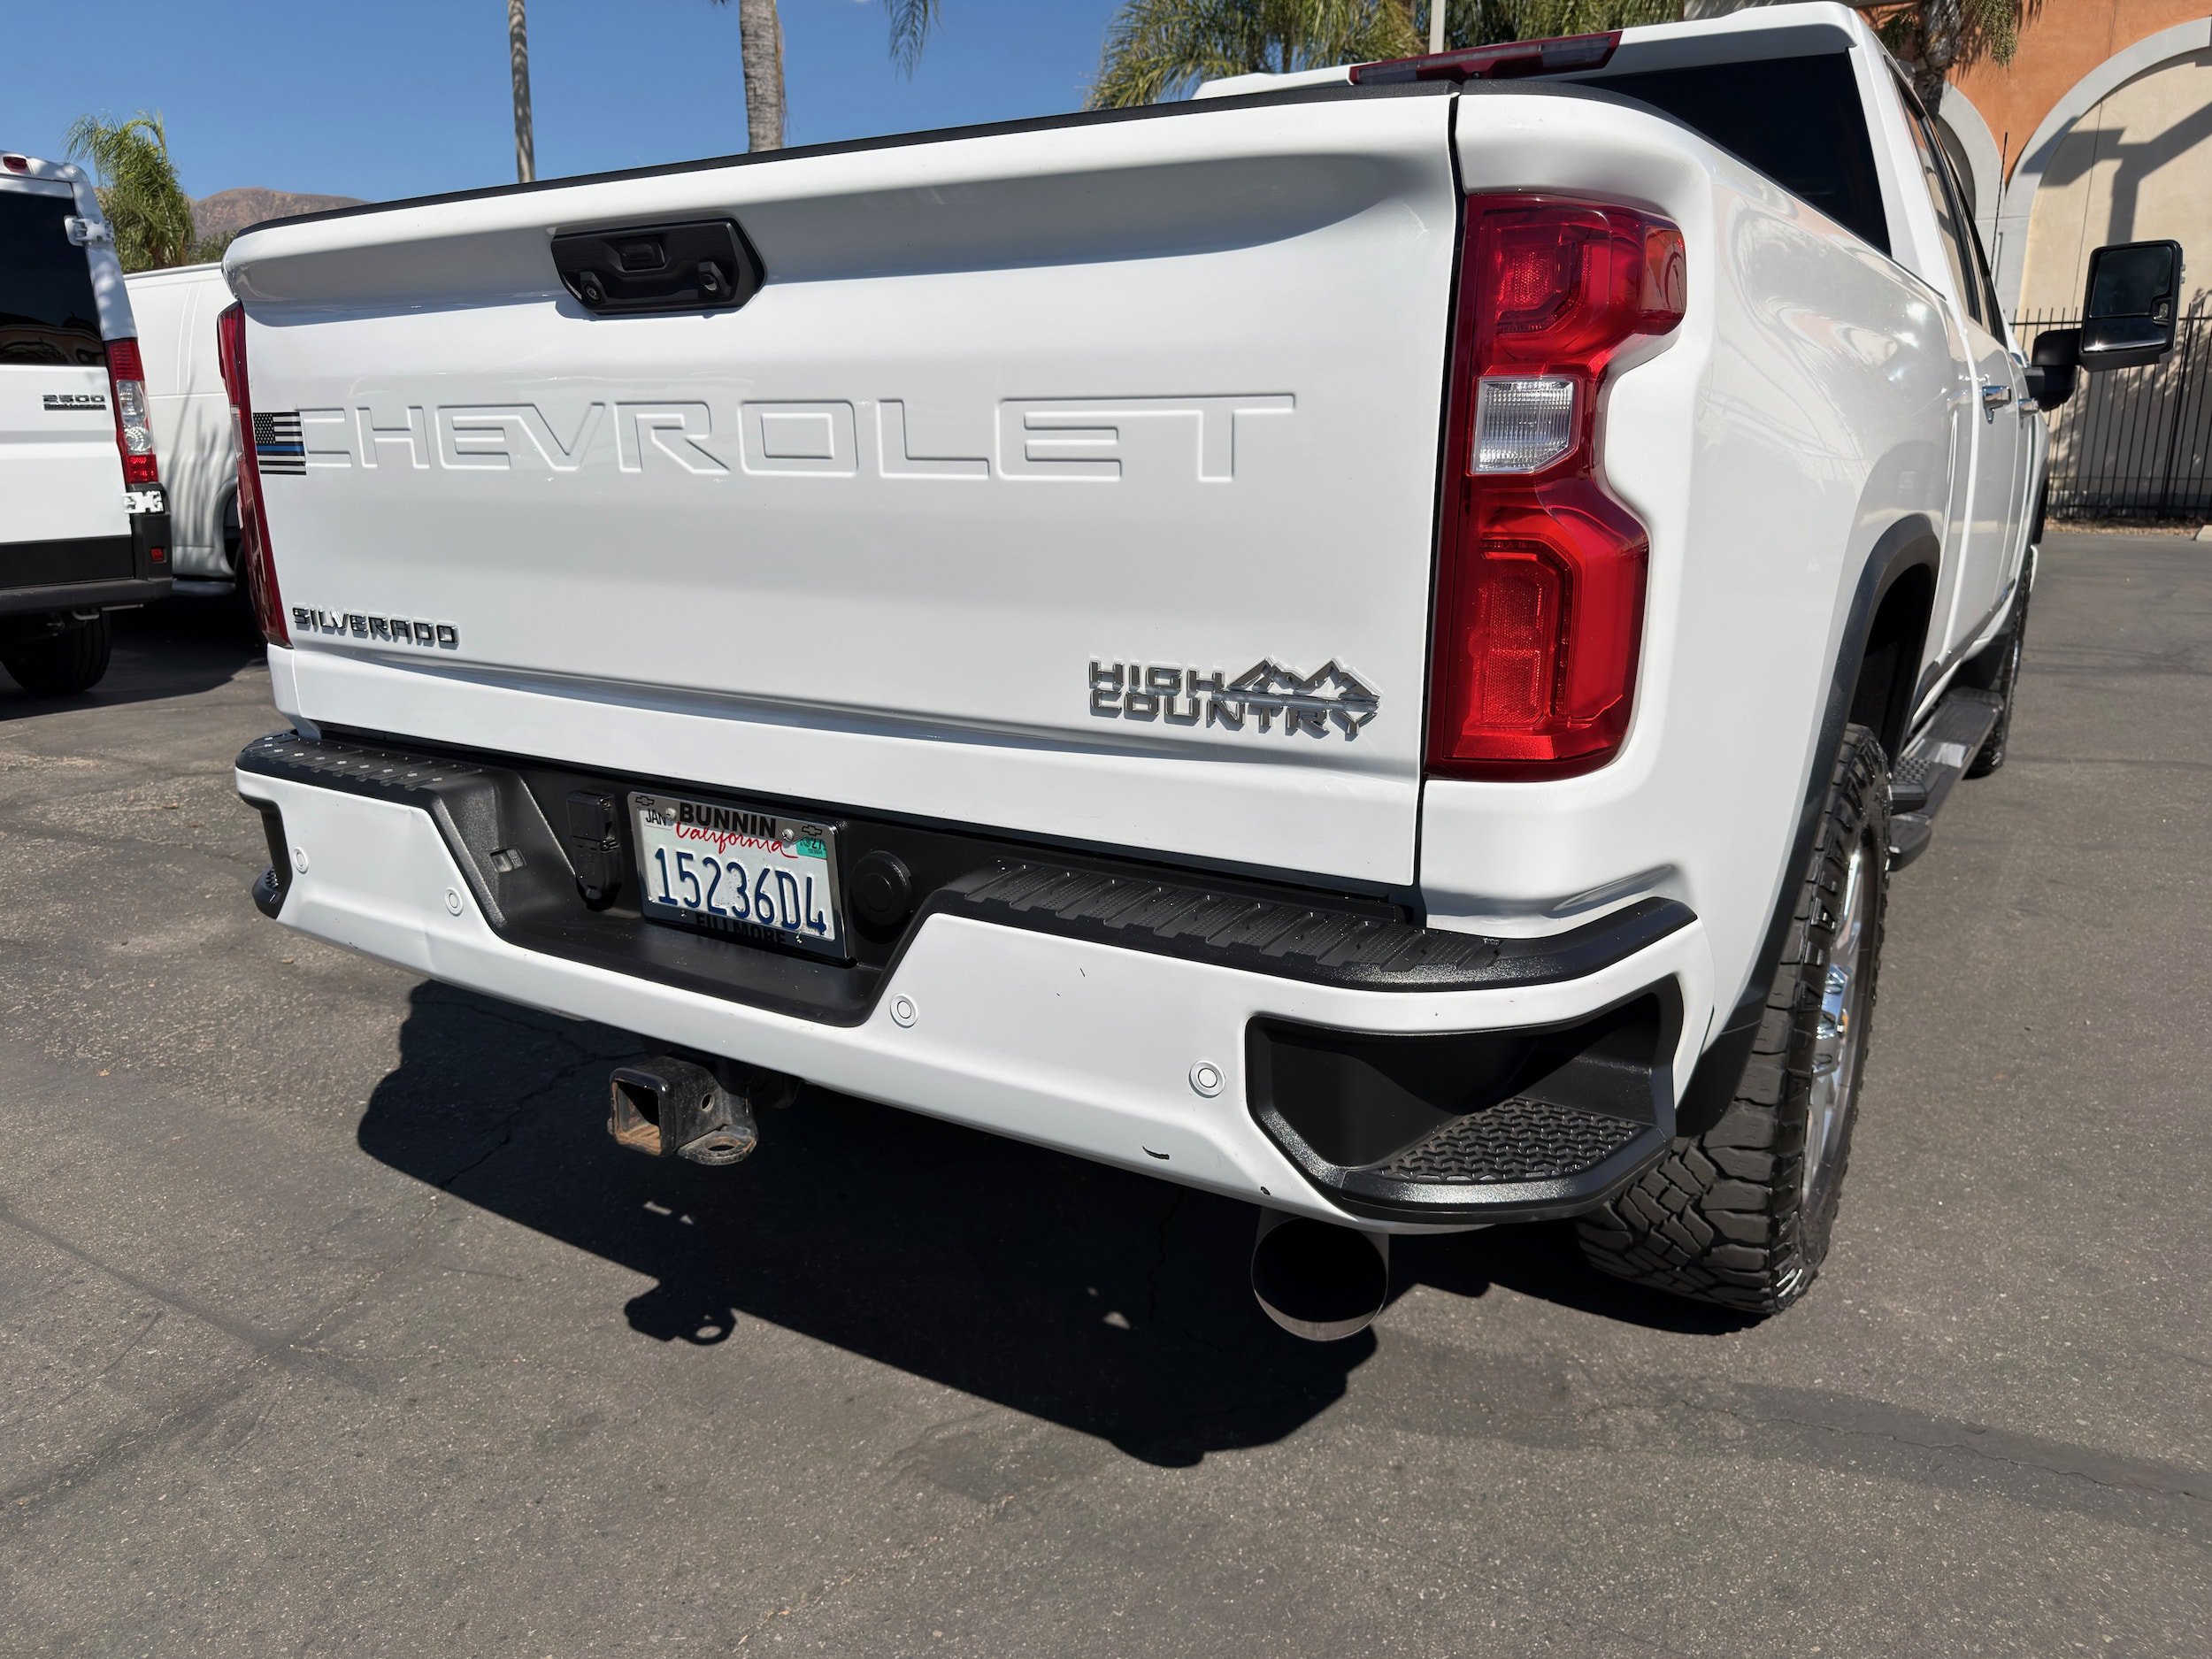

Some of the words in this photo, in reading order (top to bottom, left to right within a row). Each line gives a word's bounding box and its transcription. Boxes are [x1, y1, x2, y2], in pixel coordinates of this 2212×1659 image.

[296, 393, 1294, 483] CHEVROLET
[292, 607, 459, 643] SILVERADO
[1088, 660, 1227, 698] HIGH
[1090, 688, 1377, 740] COUNTRY
[645, 809, 667, 826] JAN
[680, 803, 776, 838] BUNNIN
[675, 822, 798, 858] California
[655, 848, 826, 935] 15236D4
